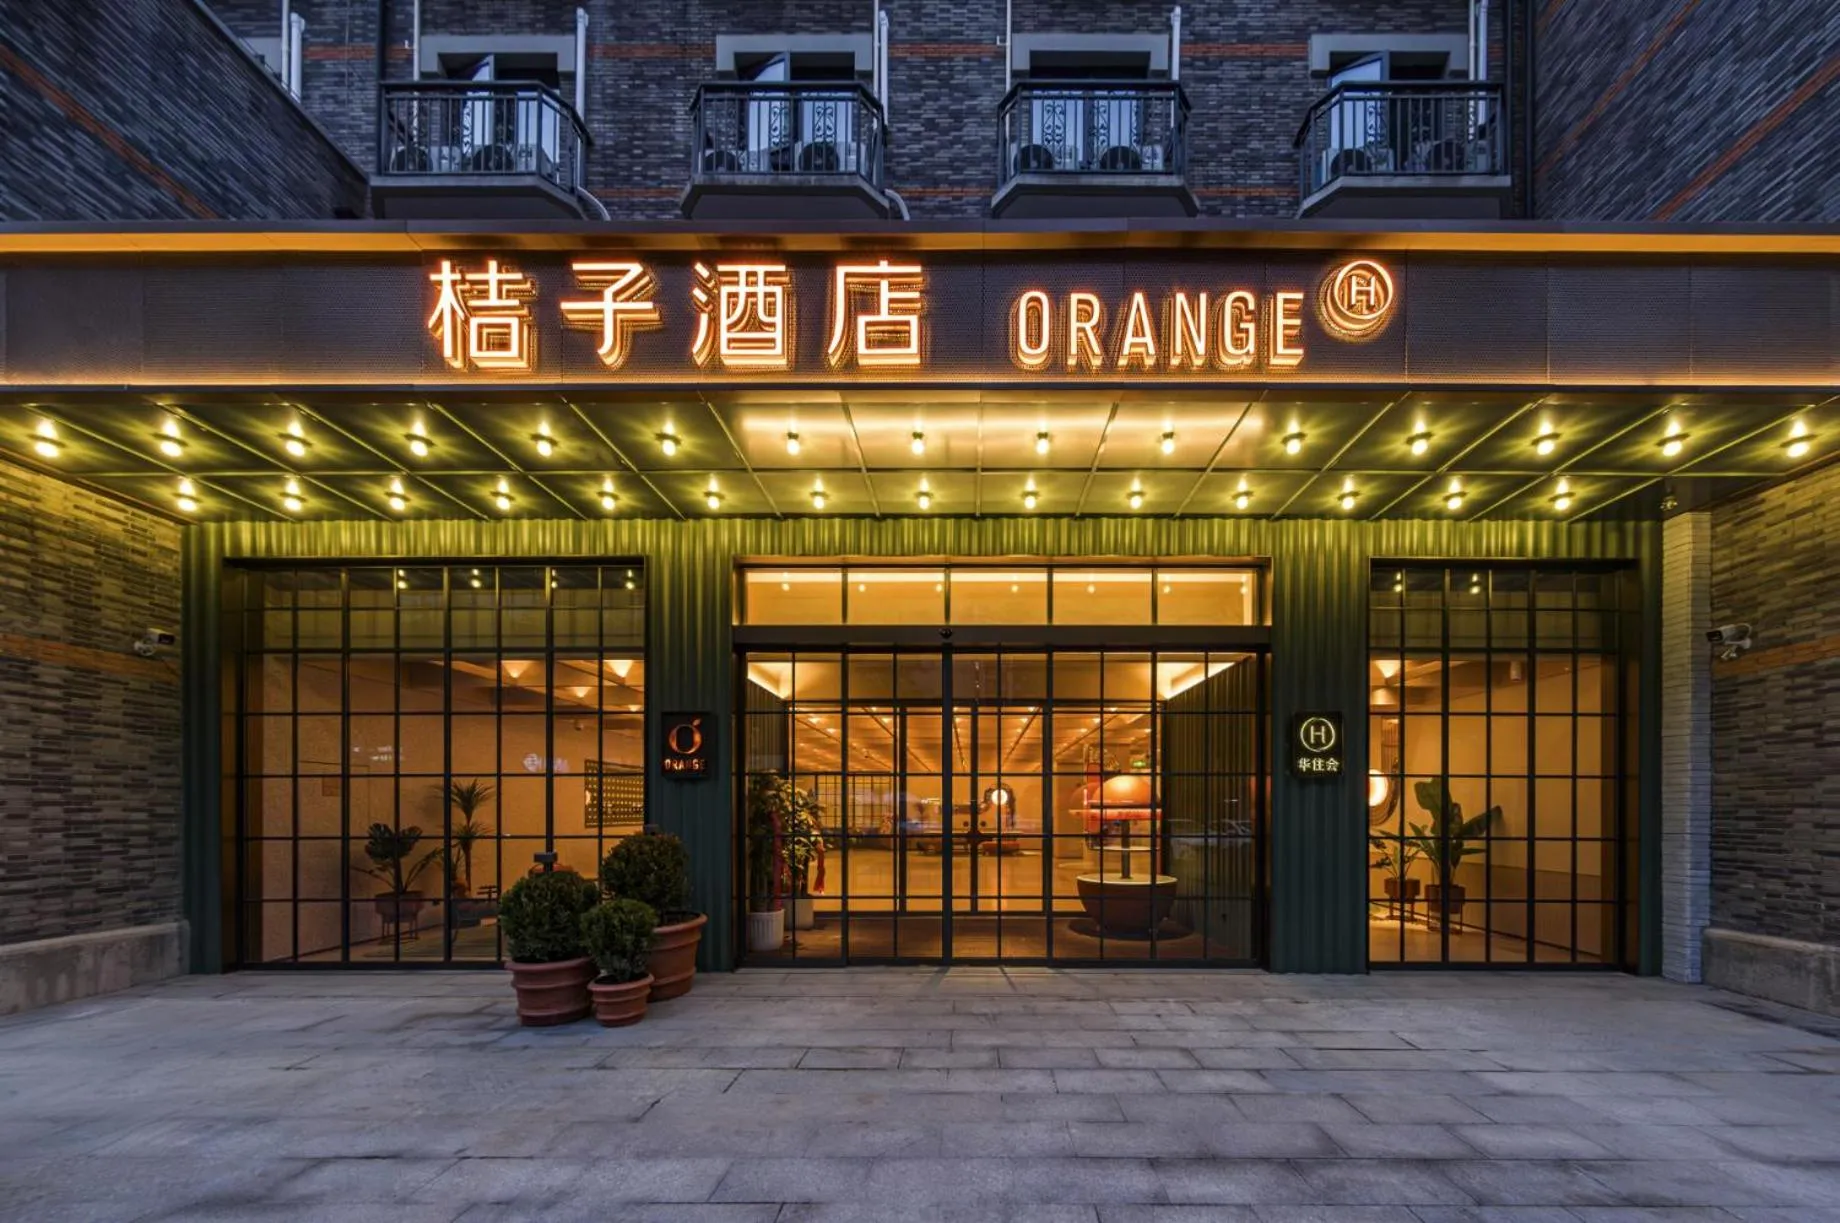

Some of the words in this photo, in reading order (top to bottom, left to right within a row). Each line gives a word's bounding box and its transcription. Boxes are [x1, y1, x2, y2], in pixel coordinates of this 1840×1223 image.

[428, 259, 922, 364] 桔子酒店
[1014, 290, 1305, 364] ORANGE
